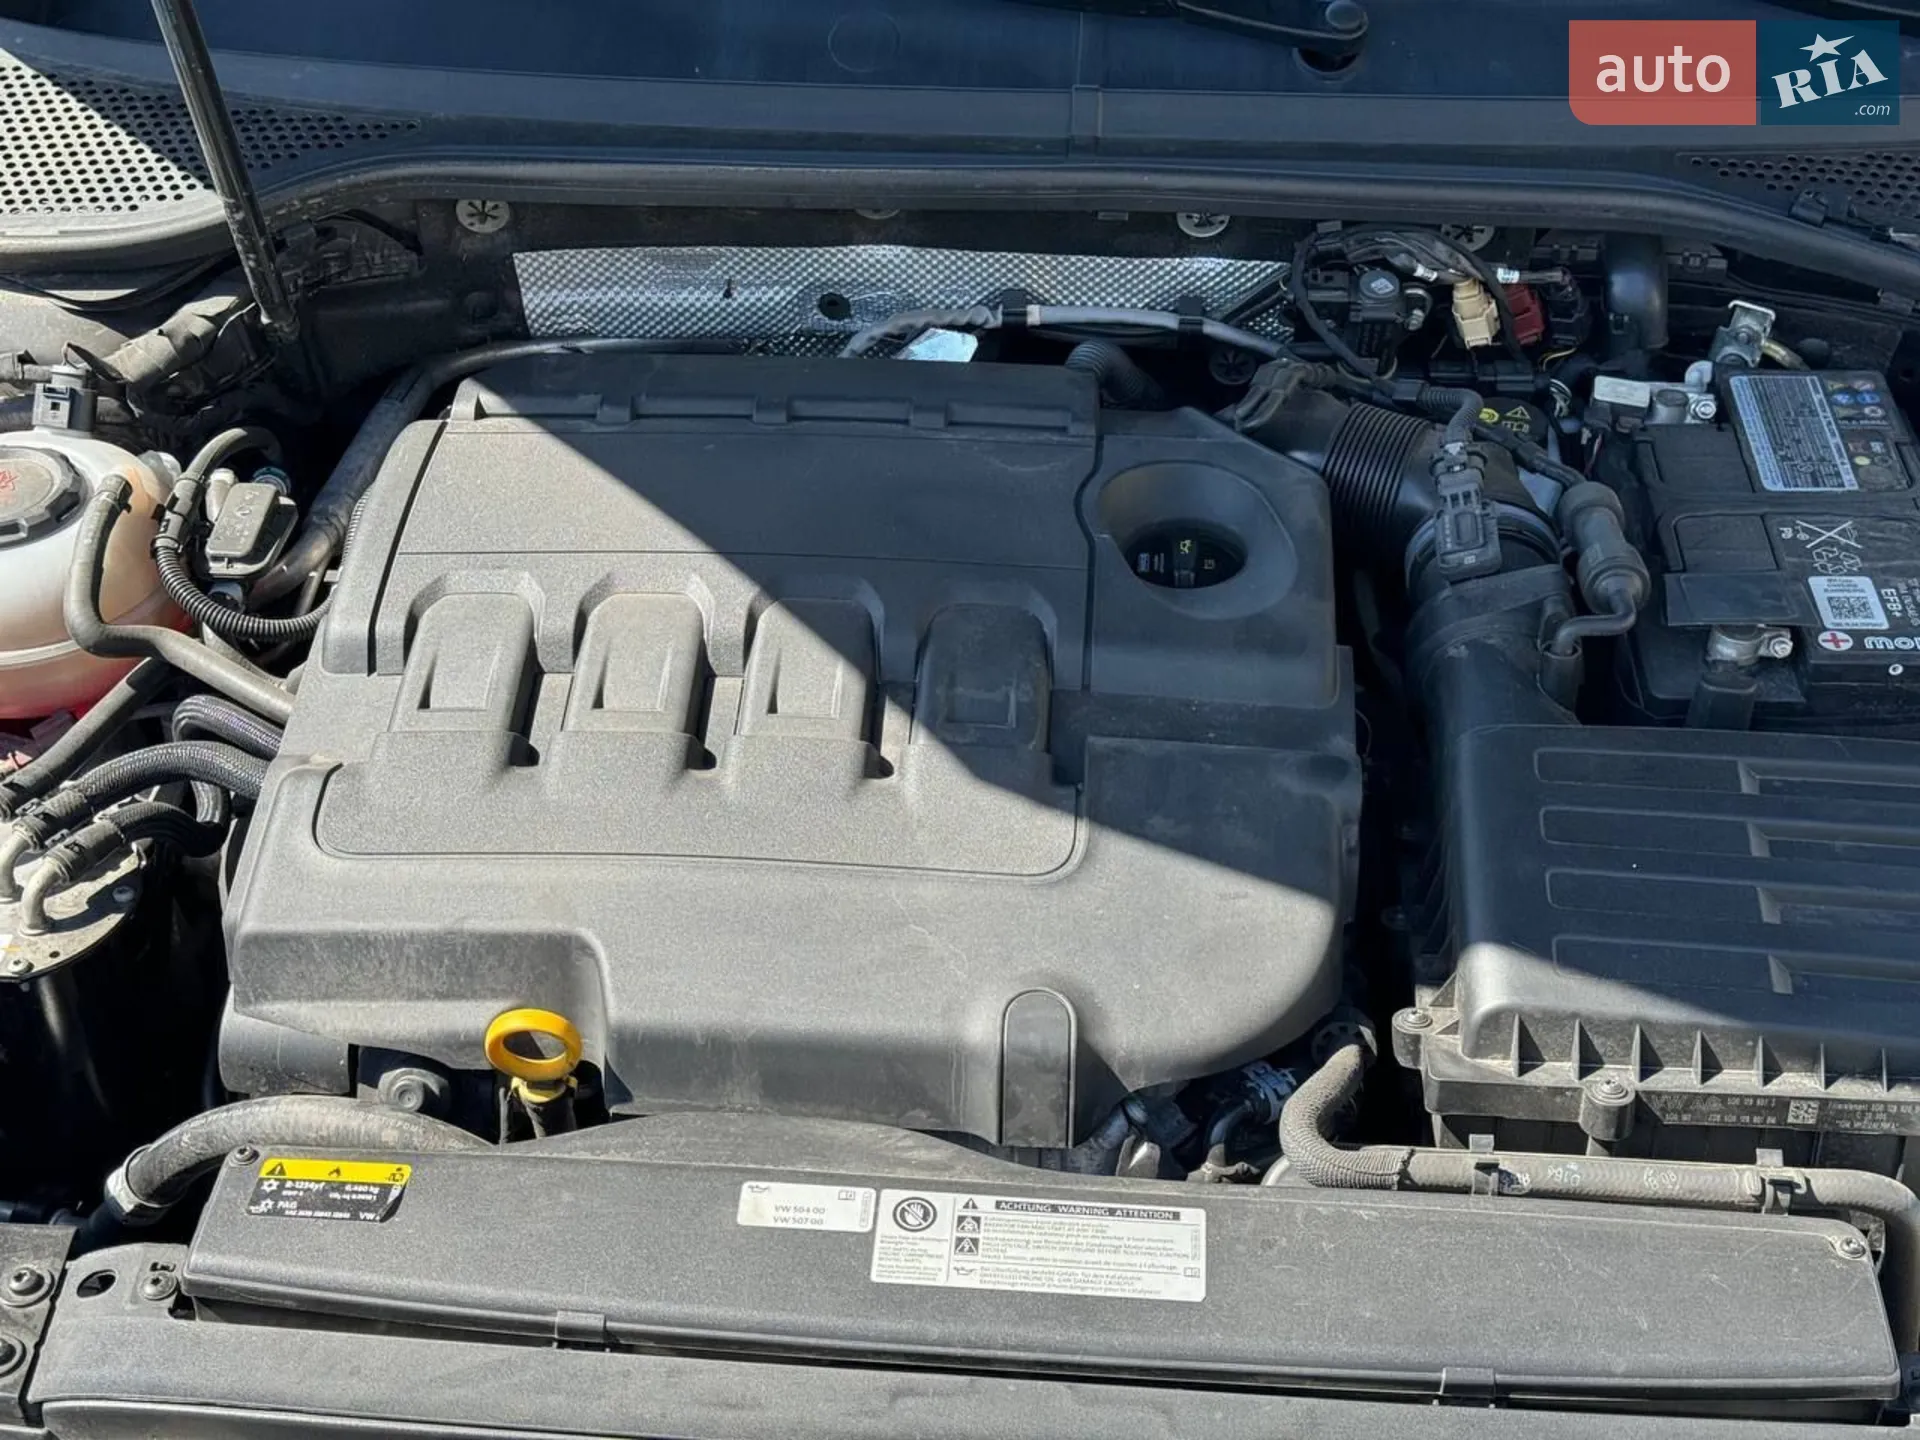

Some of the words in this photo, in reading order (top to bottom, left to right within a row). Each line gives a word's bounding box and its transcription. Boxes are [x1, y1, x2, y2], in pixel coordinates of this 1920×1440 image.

[774, 1204, 791, 1213] VW
[812, 1206, 826, 1215] 00
[1000, 1201, 1052, 1213] ACHTUNG
[1057, 1204, 1110, 1216] WARNING
[1115, 1208, 1174, 1221] ATTENTION
[772, 1215, 790, 1224] VW
[791, 1216, 809, 1225] 507
[810, 1217, 824, 1225] 00
